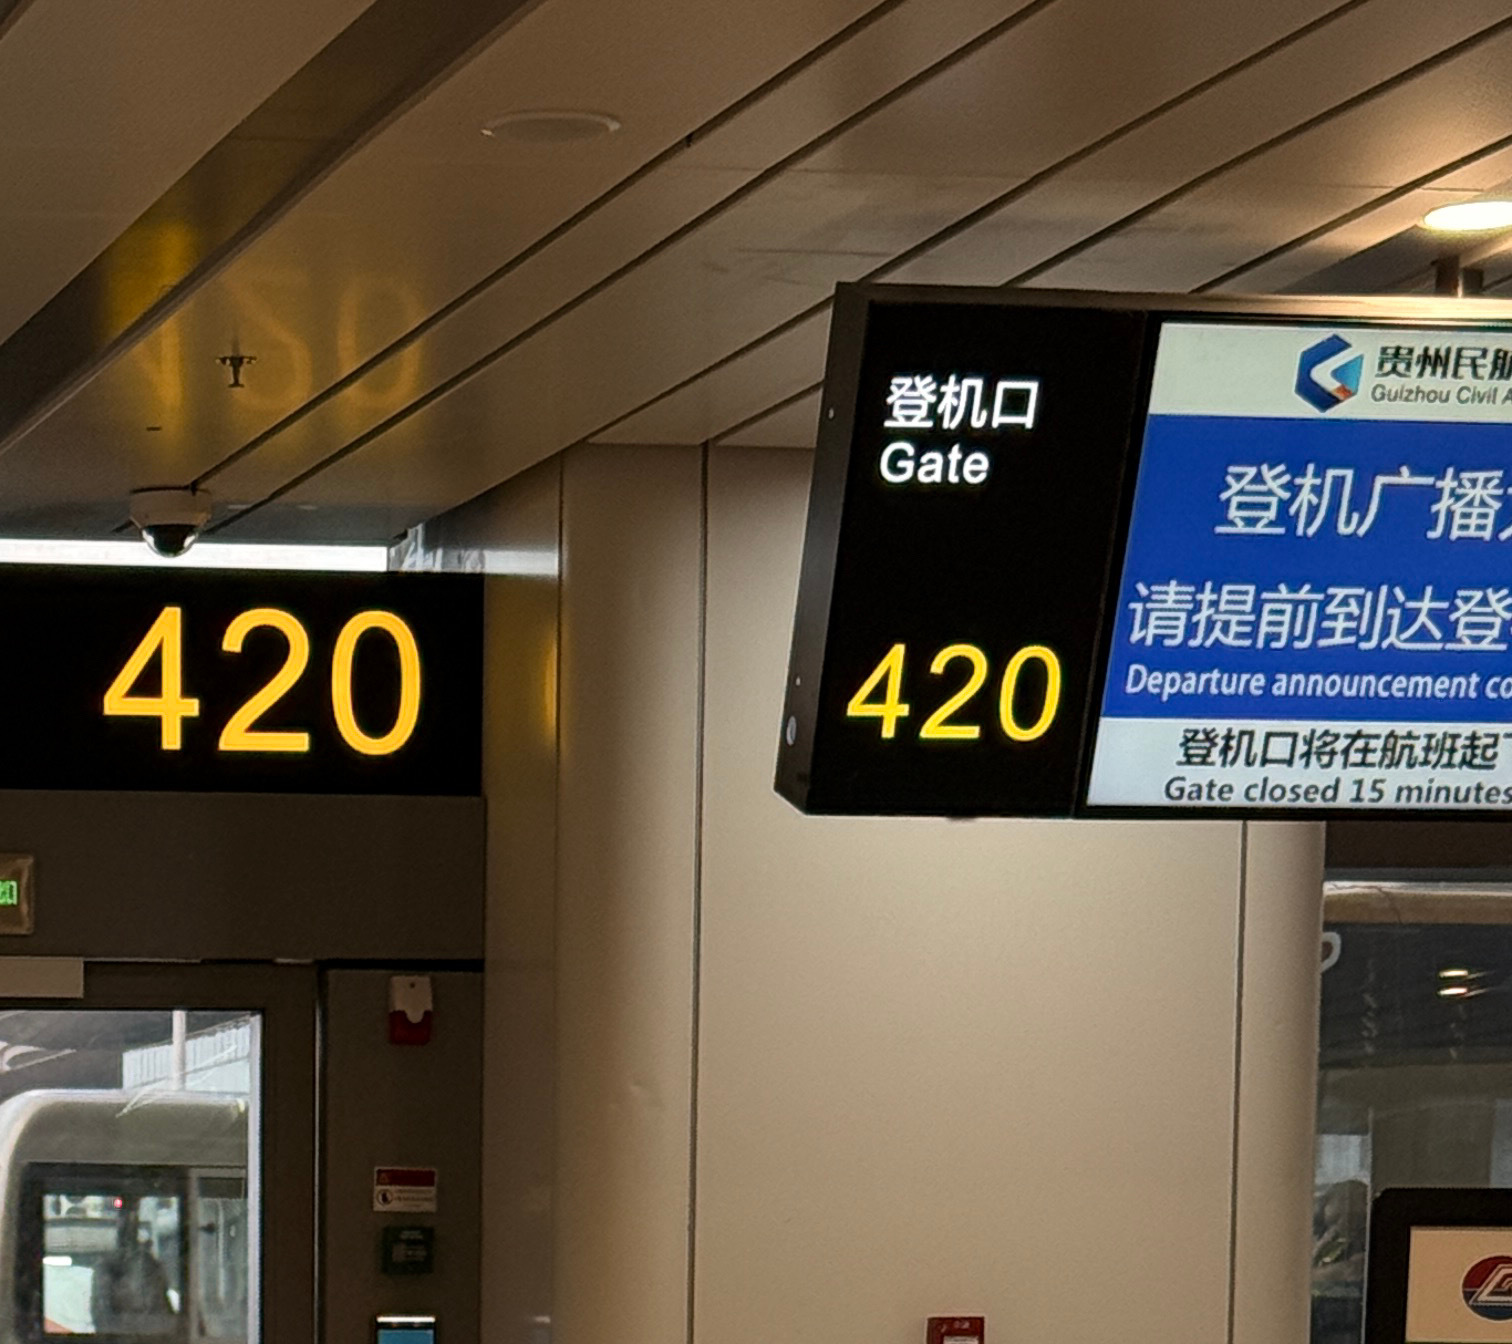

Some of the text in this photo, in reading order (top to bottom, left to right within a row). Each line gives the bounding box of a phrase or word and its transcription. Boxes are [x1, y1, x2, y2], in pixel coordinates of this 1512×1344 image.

[883, 374, 1039, 430] 登机口
[1371, 384, 1451, 405] Guizhou
[1456, 386, 1498, 406] Civil
[880, 440, 990, 484] Gate
[1214, 463, 1512, 542] 登机广播
[1127, 580, 1512, 652] 请提前到达登
[103, 606, 421, 755] 420
[846, 643, 1062, 742] 420
[1125, 663, 1265, 702] Departure
[1272, 671, 1478, 699] announcement
[1176, 728, 1512, 770] 登机口将在航班起
[1164, 776, 1234, 802] Gate
[1243, 776, 1341, 803] closed
[1349, 778, 1386, 804] 15
